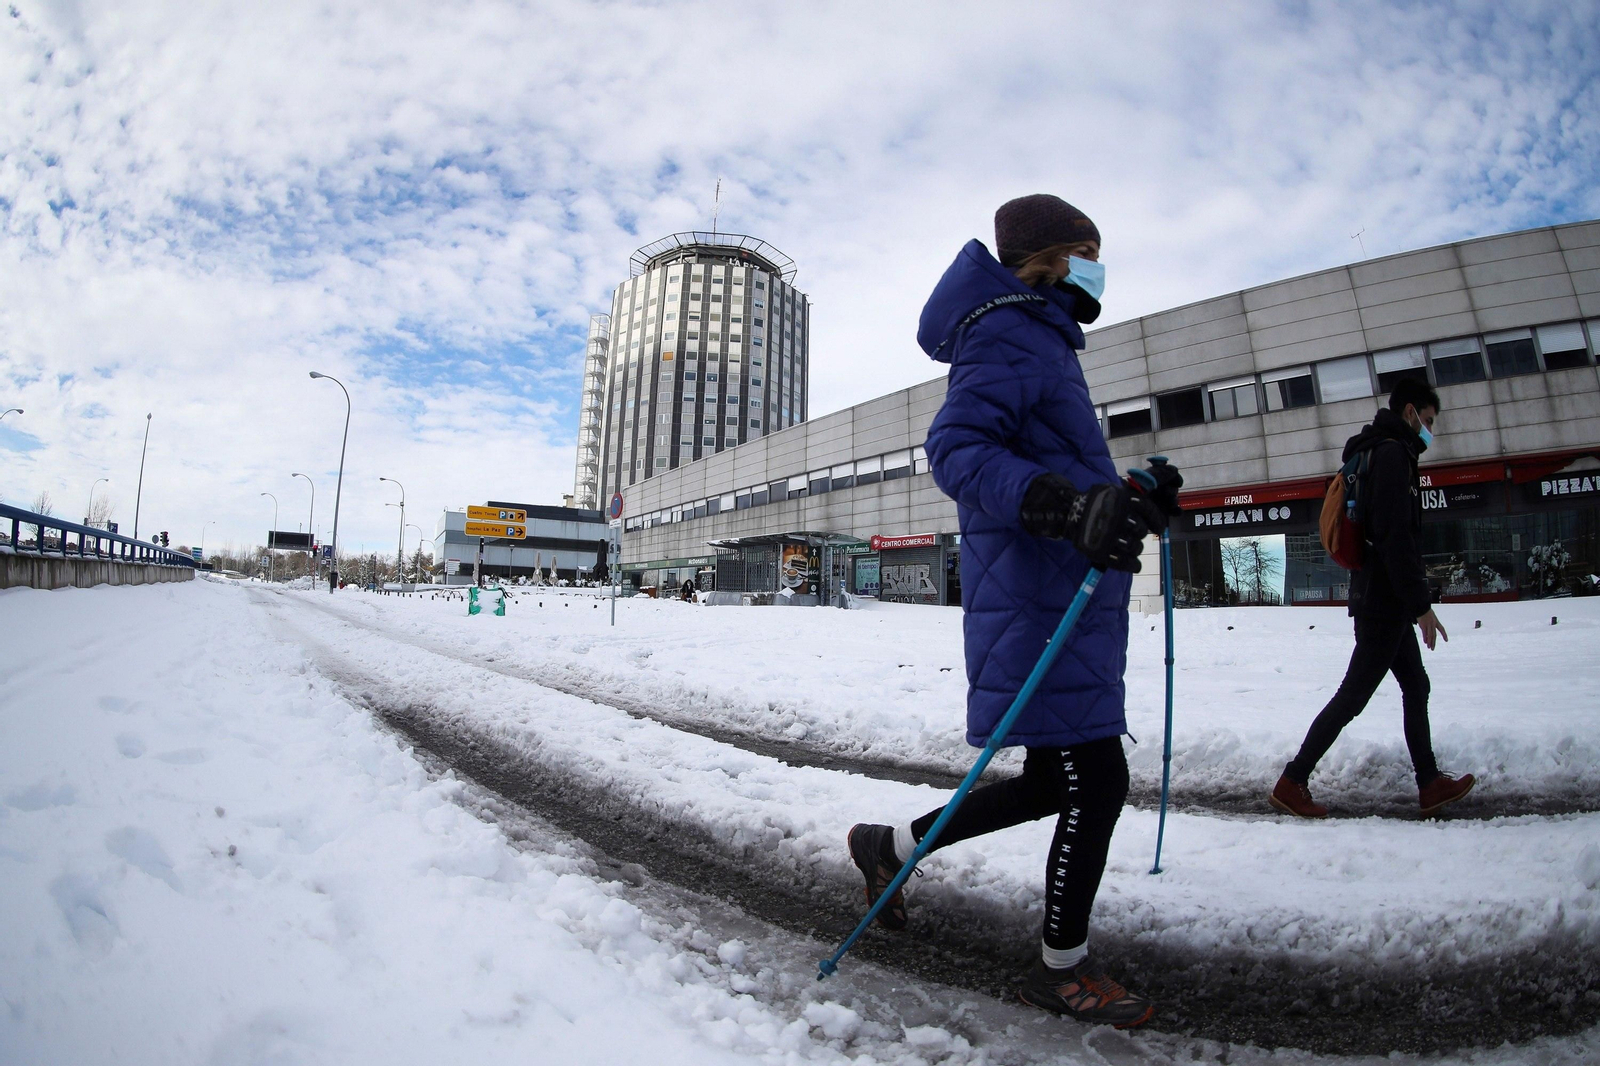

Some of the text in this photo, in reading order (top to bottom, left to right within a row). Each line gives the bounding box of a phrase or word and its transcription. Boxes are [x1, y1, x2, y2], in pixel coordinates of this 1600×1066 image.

[971, 302, 994, 318] LOLA
[994, 294, 1025, 305] BIMBA
[1230, 495, 1253, 505] PAUSA
[1421, 489, 1448, 510] USA
[1454, 493, 1476, 501] cafeteria
[1194, 506, 1291, 527] PIZZA'N CO
[881, 538, 933, 548] CENTRO COMERCIAL
[1305, 590, 1323, 599] PAUSA
[1054, 844, 1071, 896] TENTH
[1067, 804, 1081, 833] TEN
